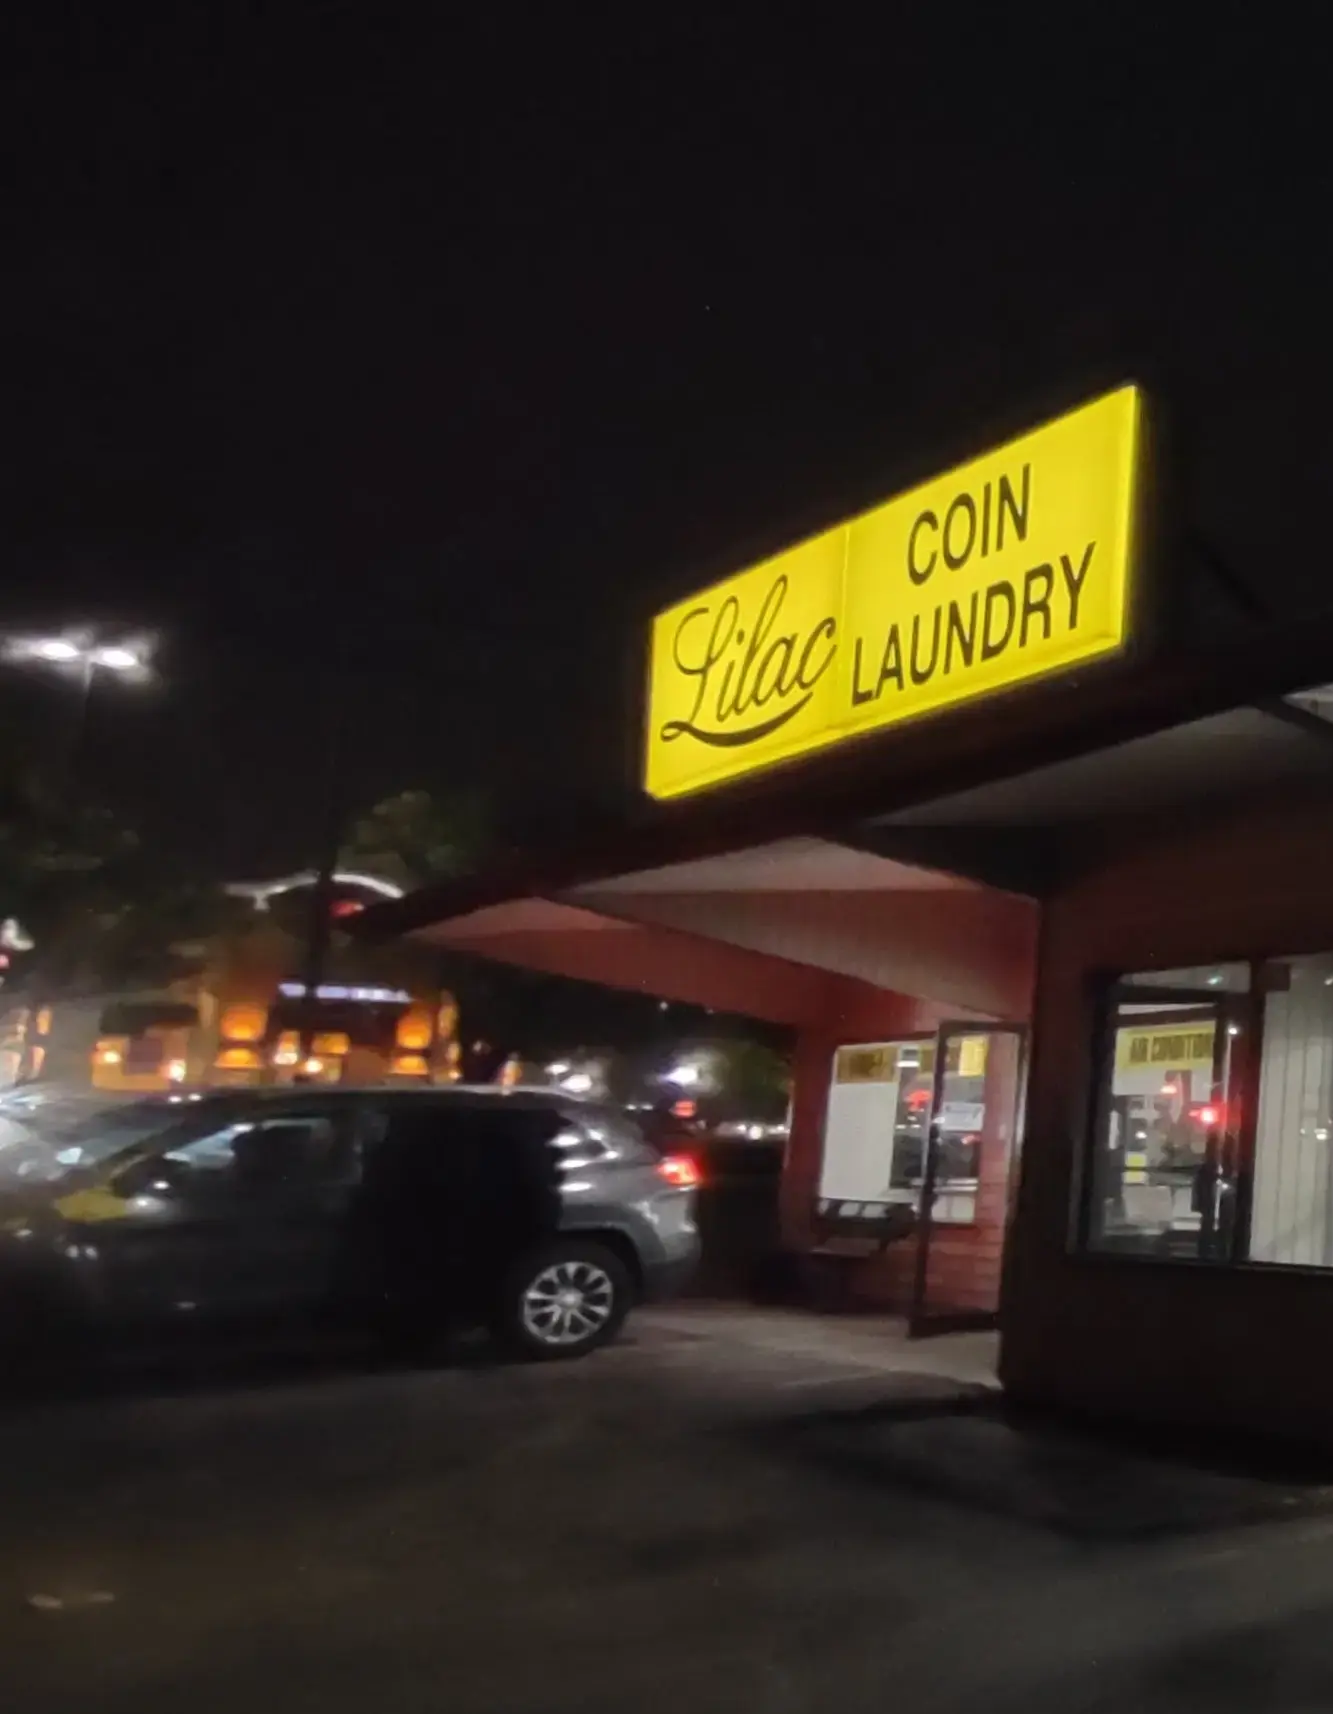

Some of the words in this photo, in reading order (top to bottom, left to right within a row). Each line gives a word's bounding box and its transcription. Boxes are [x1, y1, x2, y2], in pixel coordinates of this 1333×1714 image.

[907, 463, 1031, 586] COIN
[660, 574, 839, 748] Lilac
[851, 541, 1096, 707] LAUNDRY
